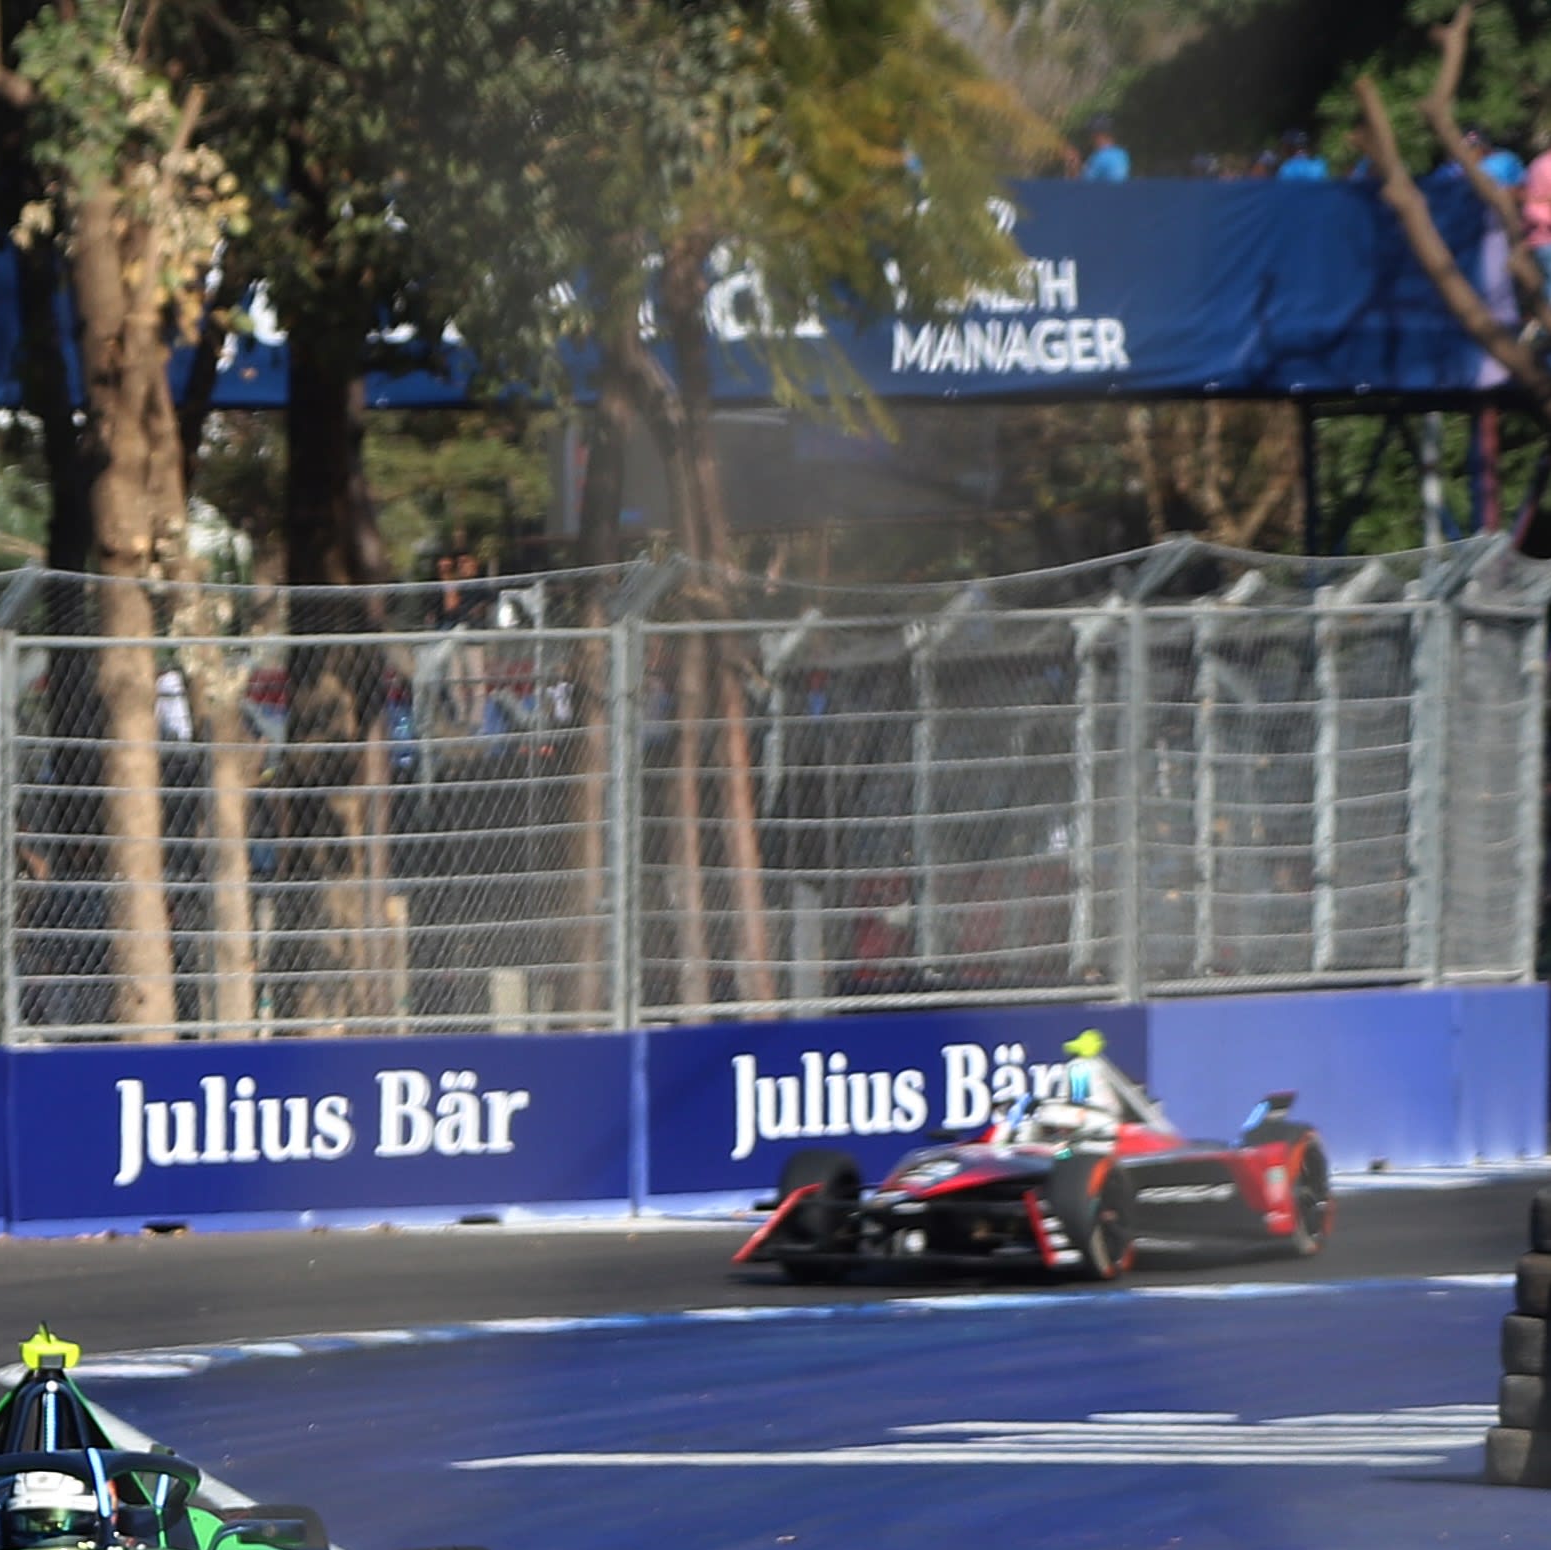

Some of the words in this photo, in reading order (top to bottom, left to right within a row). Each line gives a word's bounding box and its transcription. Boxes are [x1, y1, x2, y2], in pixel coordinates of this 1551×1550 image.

[891, 318, 1131, 374] MANAGER
[113, 1075, 354, 1187] Julius
[374, 1070, 530, 1157] Bär
[730, 1051, 928, 1160] Julius
[941, 1043, 1068, 1129] Bär
